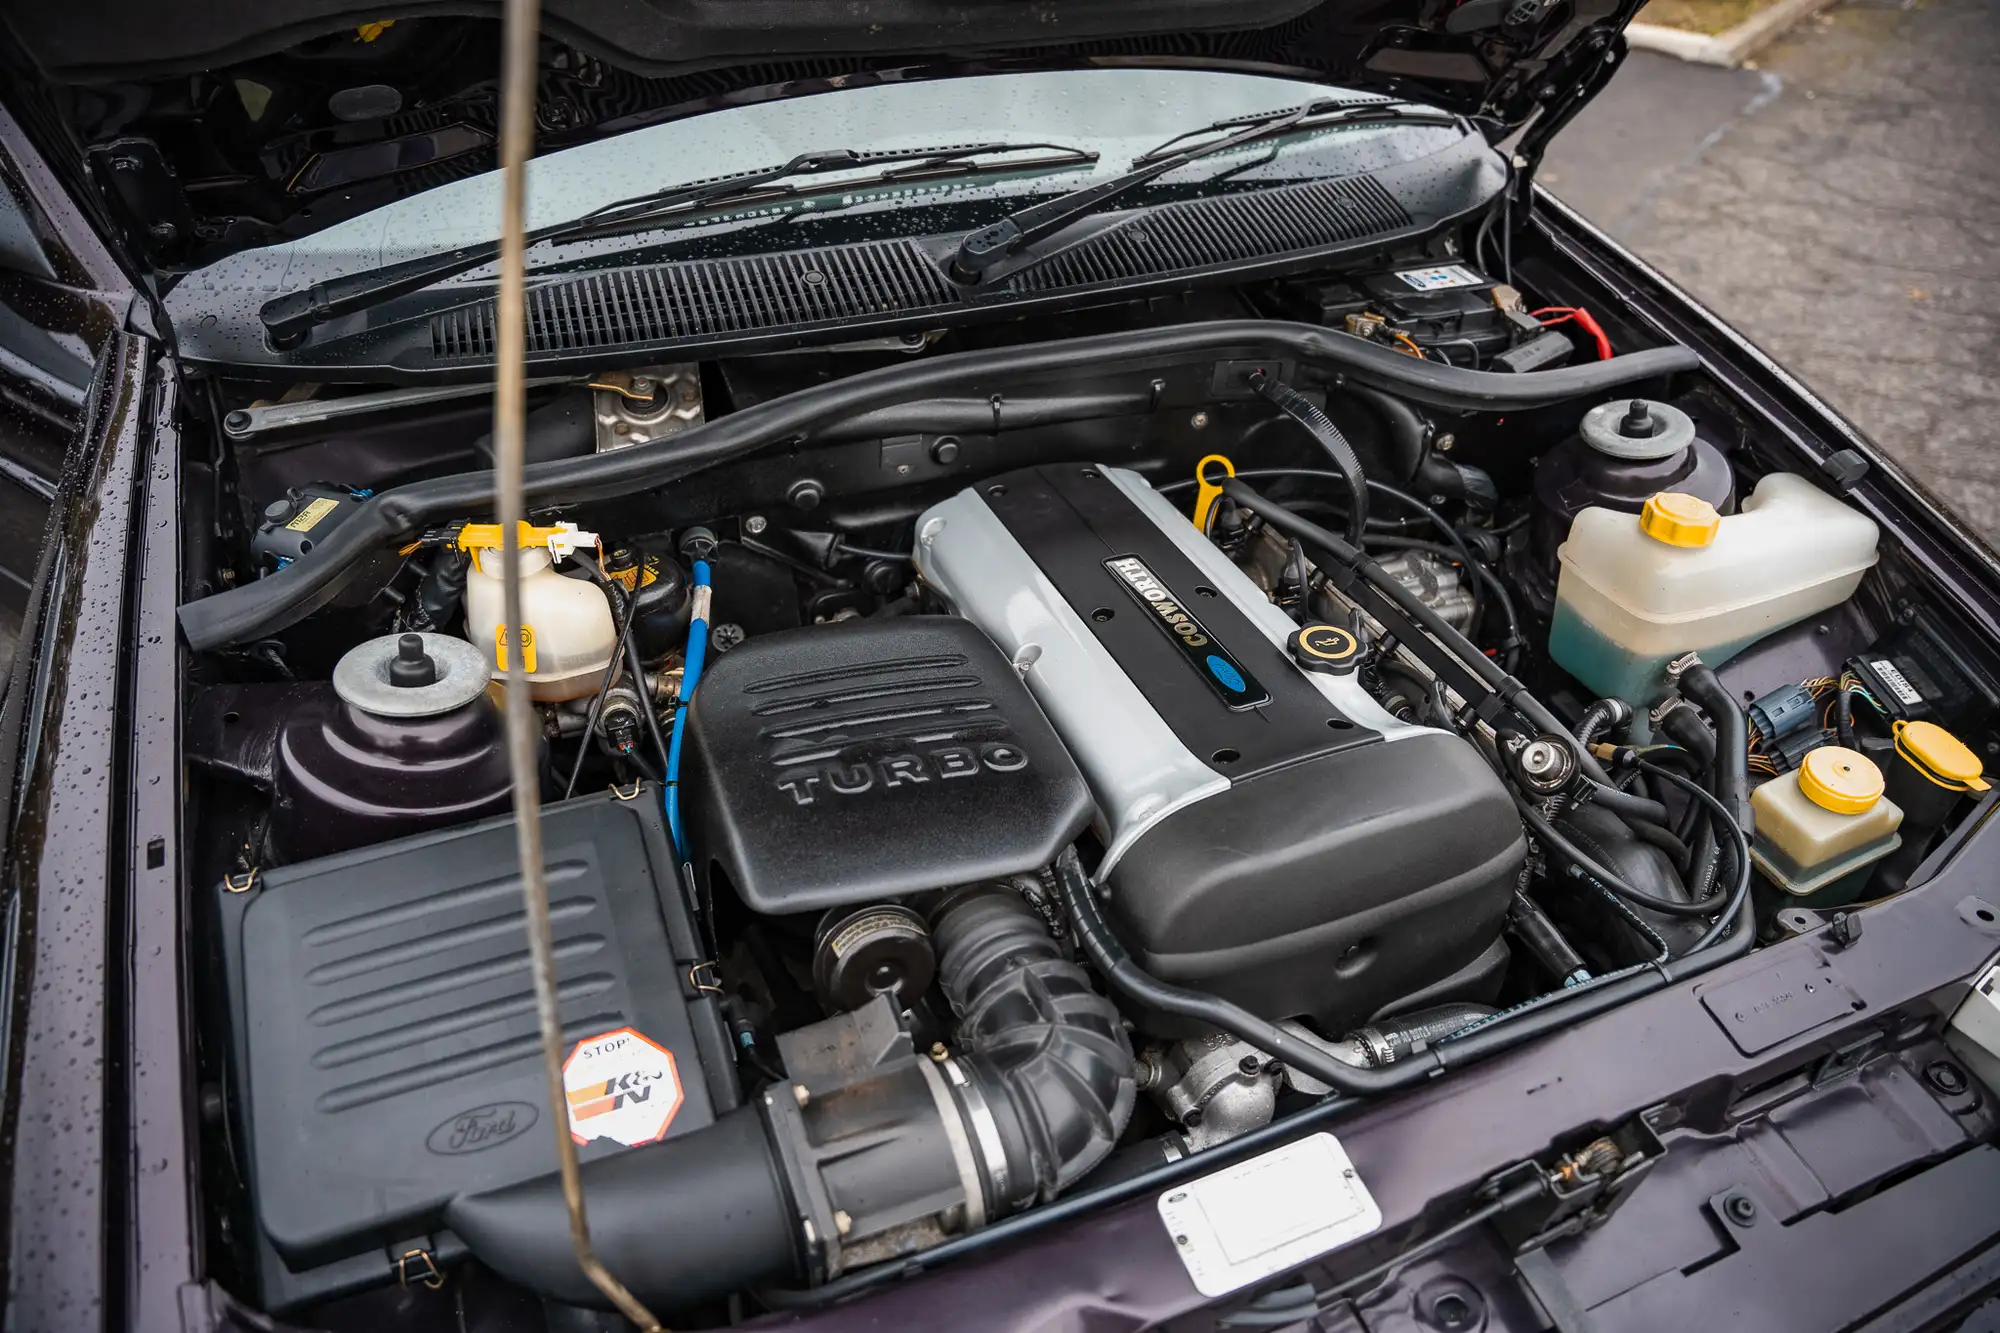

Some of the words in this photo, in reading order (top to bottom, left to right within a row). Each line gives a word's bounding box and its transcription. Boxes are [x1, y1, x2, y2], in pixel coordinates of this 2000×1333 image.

[1114, 557, 1208, 646] COSWORTH
[776, 742, 1029, 805] TURBO
[448, 1108, 516, 1149] Ford
